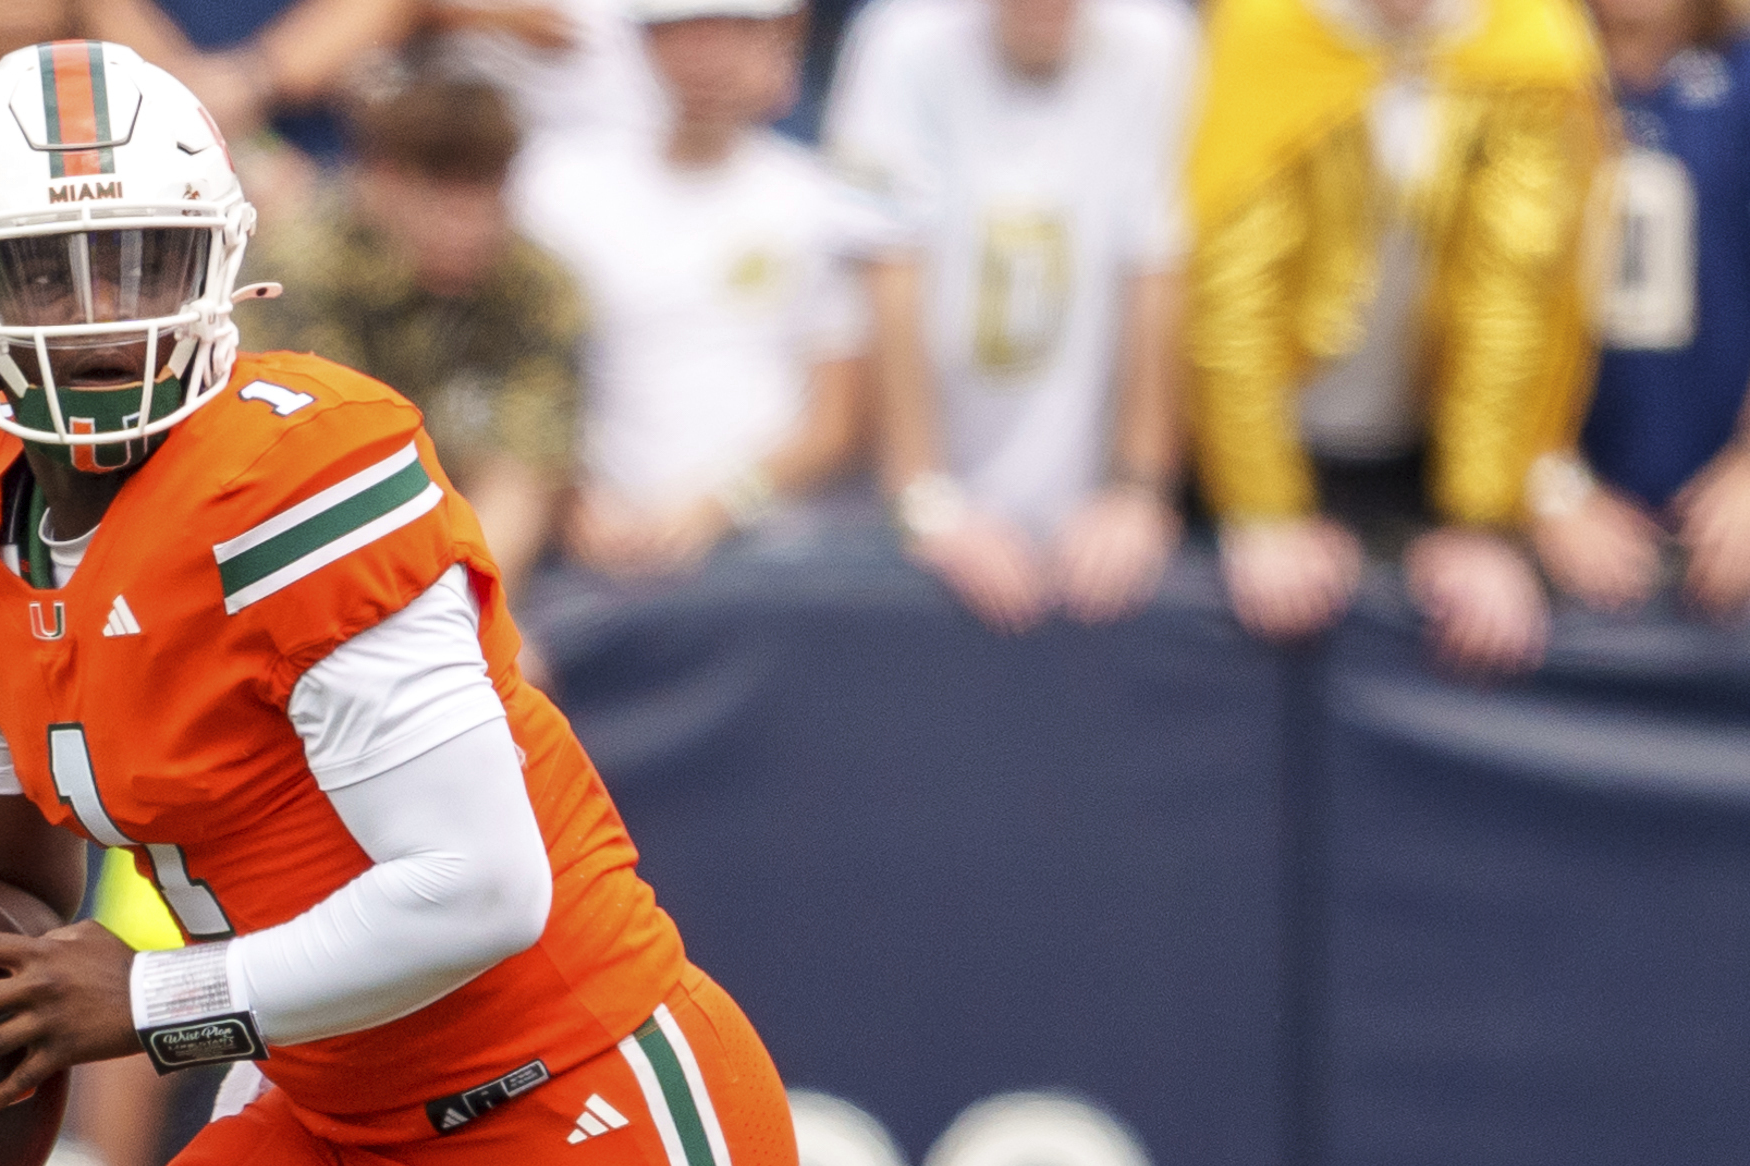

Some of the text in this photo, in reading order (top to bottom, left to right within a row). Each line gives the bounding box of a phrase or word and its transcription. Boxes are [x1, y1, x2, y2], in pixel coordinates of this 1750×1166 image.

[48, 181, 123, 204] MIAMI
[238, 379, 315, 417] 1
[29, 601, 65, 640] U
[47, 721, 237, 942] 1
